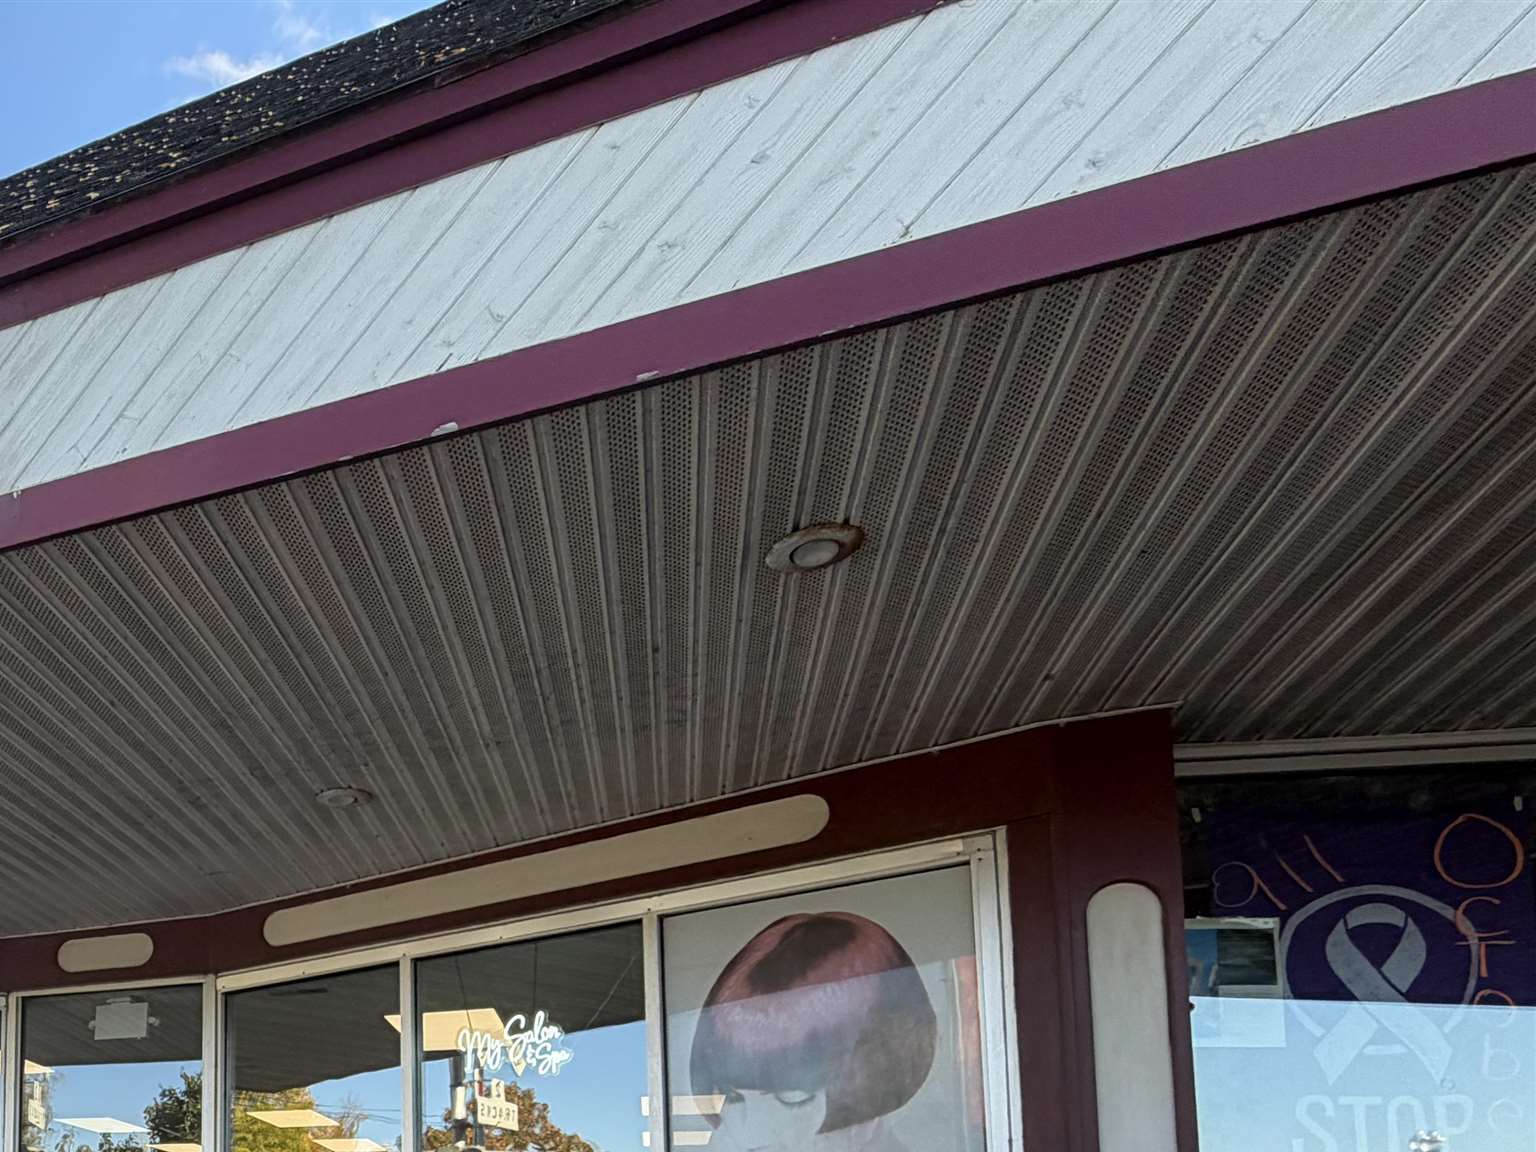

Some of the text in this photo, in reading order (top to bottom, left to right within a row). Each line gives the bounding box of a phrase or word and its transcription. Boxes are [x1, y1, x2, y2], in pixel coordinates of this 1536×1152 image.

[457, 1010, 562, 1073] My Salon
[535, 1042, 570, 1075] Spa
